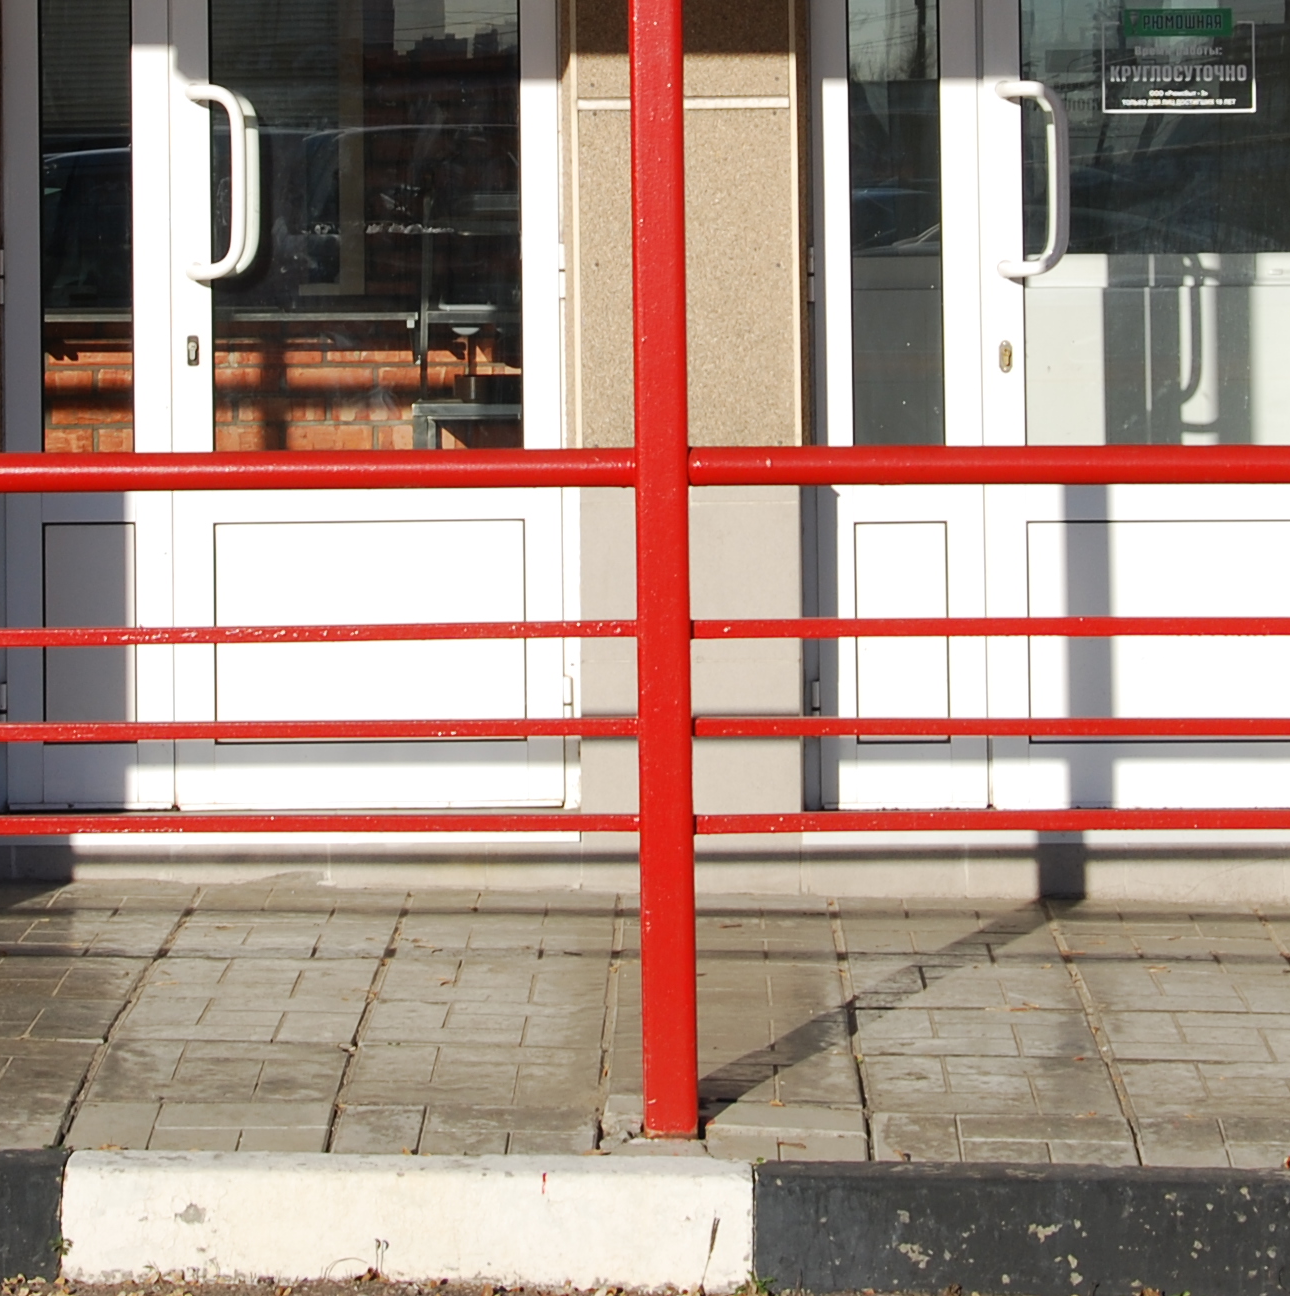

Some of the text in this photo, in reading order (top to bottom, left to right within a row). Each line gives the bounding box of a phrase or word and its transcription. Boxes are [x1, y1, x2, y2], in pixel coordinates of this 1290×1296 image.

[1142, 14, 1222, 29] РЮМОШНАЯ
[1134, 45, 1223, 56] Время работы:
[1110, 64, 1247, 82] КРУГЛОСУТОЧНО
